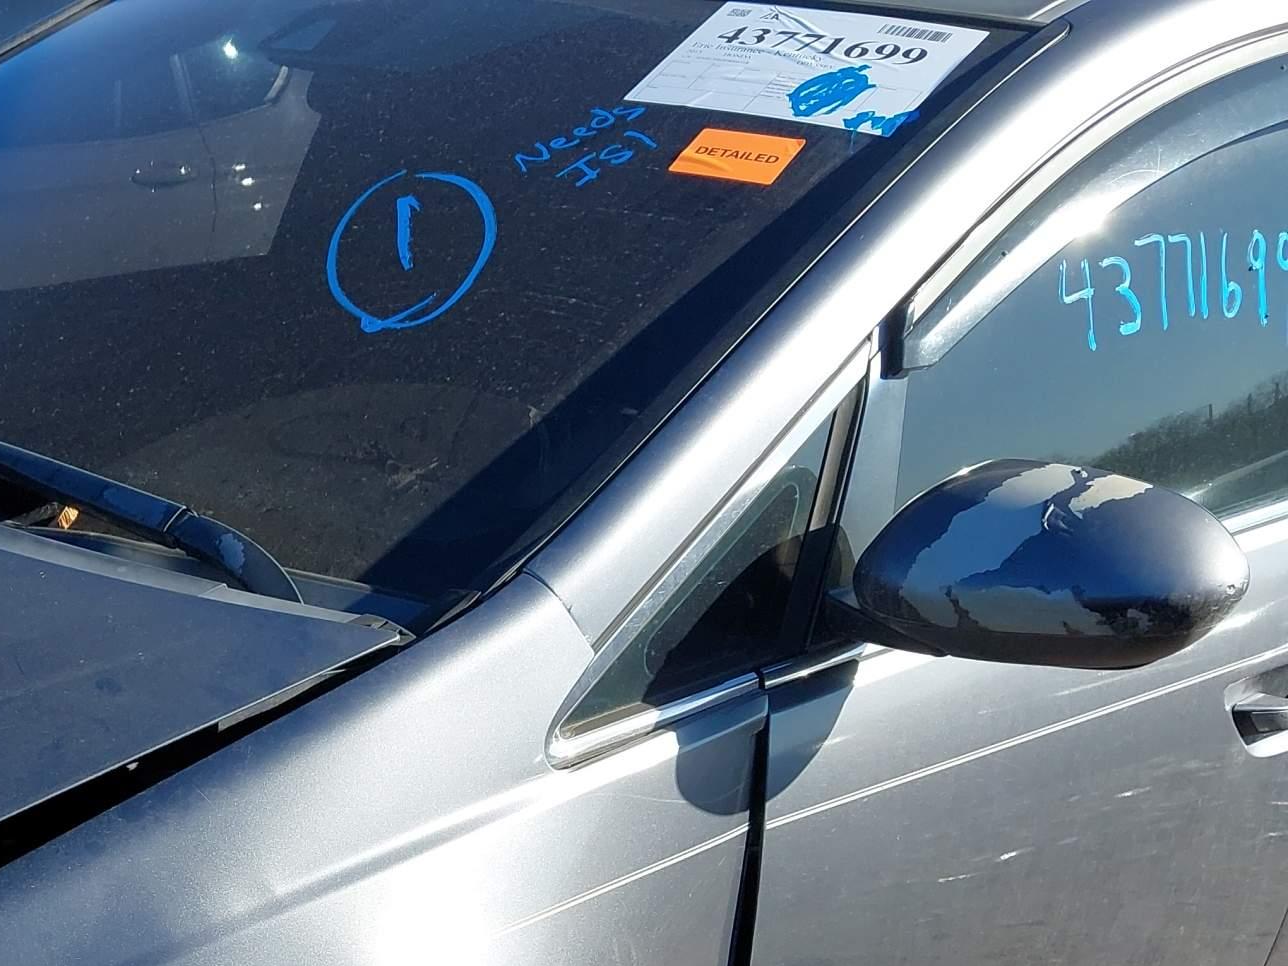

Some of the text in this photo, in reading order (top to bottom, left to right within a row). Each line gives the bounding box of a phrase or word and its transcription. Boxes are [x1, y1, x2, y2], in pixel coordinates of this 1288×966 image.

[717, 26, 928, 65] 43771699
[515, 105, 647, 173] Needs
[695, 145, 780, 165] DETAILED
